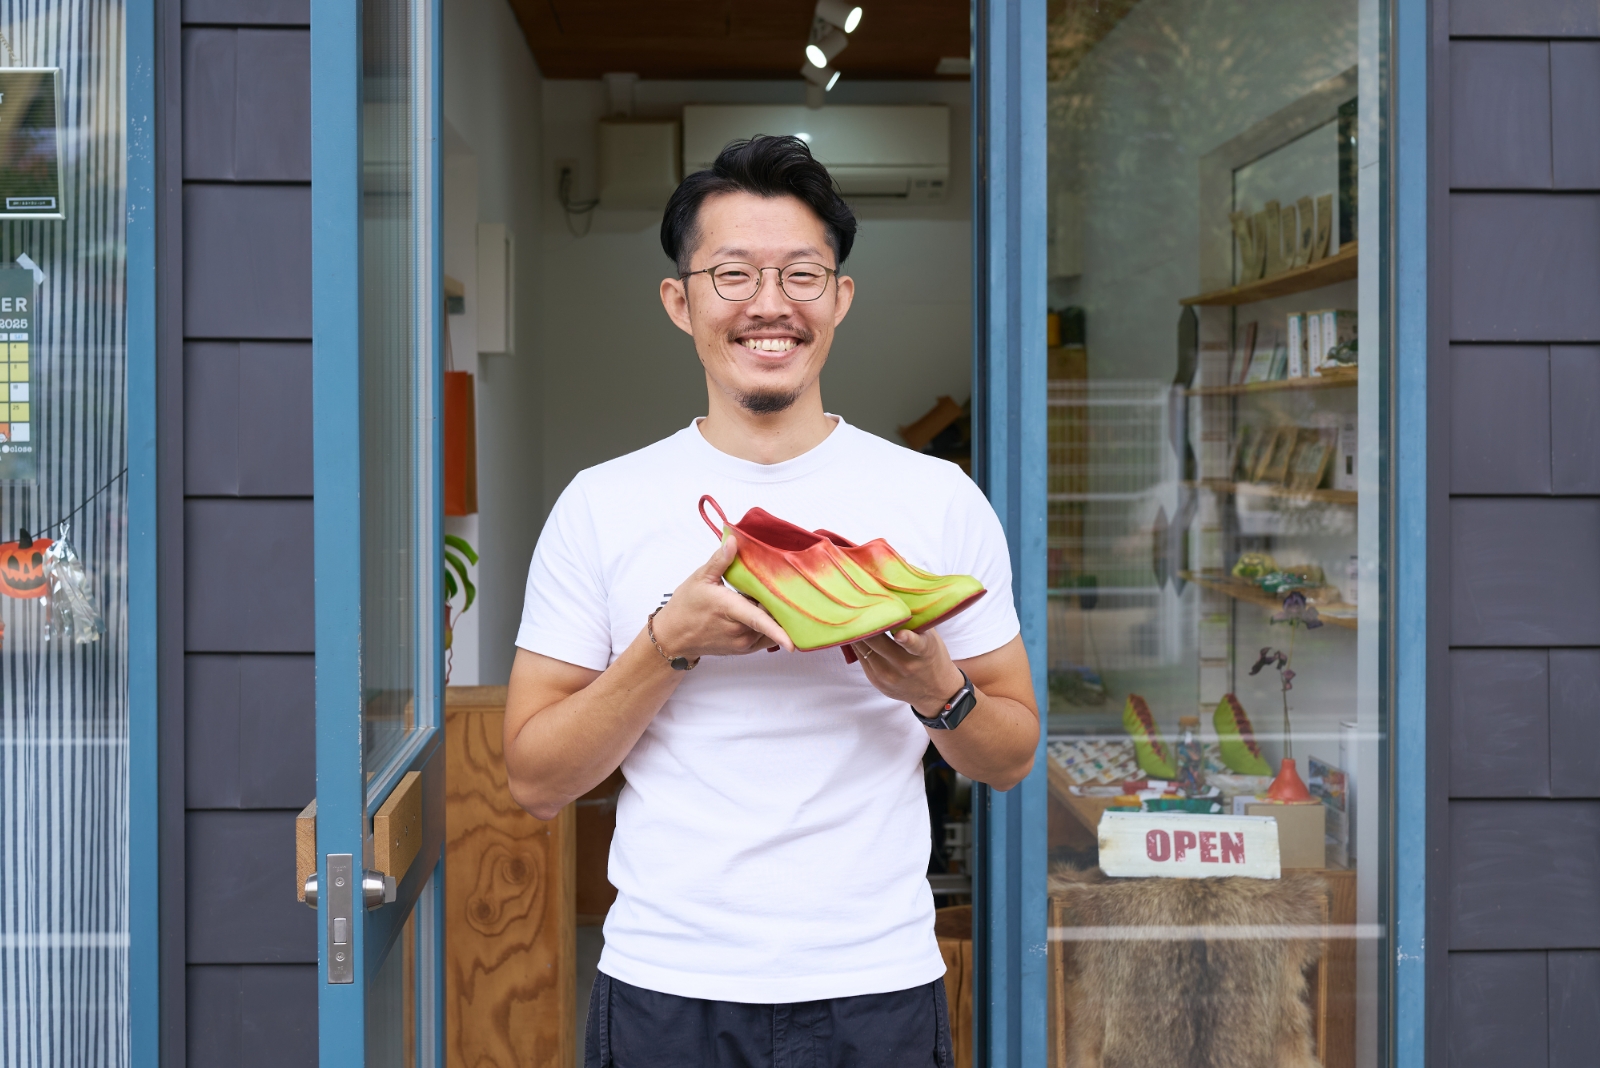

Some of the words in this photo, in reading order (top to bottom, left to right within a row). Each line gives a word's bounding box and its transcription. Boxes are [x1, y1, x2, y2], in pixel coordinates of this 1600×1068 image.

[2, 297, 27, 312] ER
[0, 319, 28, 329] 2025
[1146, 829, 1245, 864] OPEN
